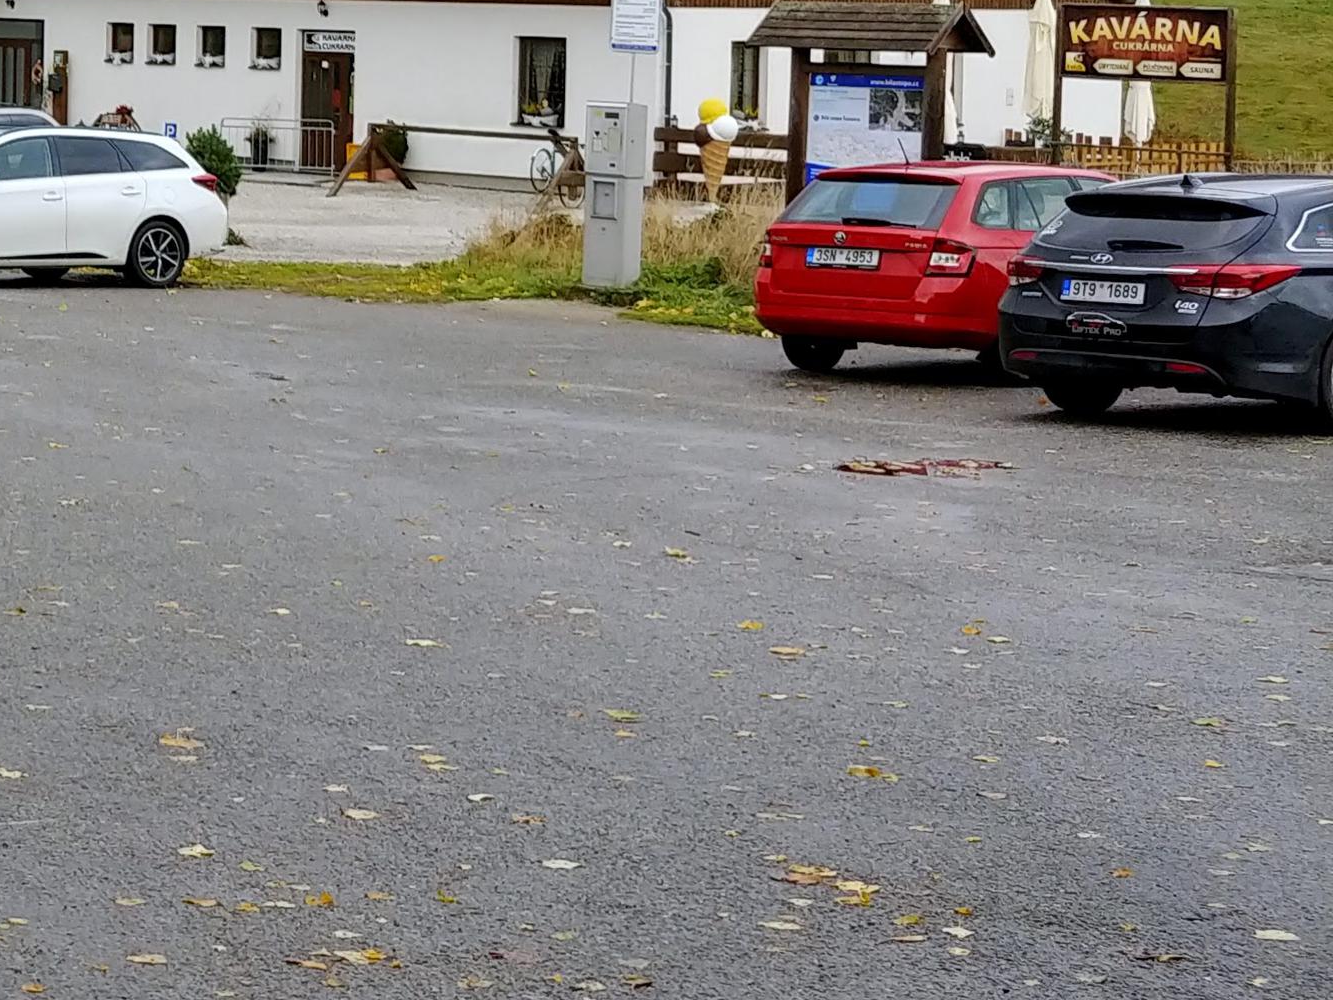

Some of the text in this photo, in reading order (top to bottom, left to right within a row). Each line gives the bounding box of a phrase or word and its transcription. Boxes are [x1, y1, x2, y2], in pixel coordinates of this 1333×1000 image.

[1069, 11, 1222, 50] KAVÁRNA
[1113, 41, 1174, 53] CUKRÁRNA
[1190, 66, 1215, 74] SAUNA
[815, 249, 873, 263] 3SN 4953
[1072, 281, 1138, 299] 9T9 1689
